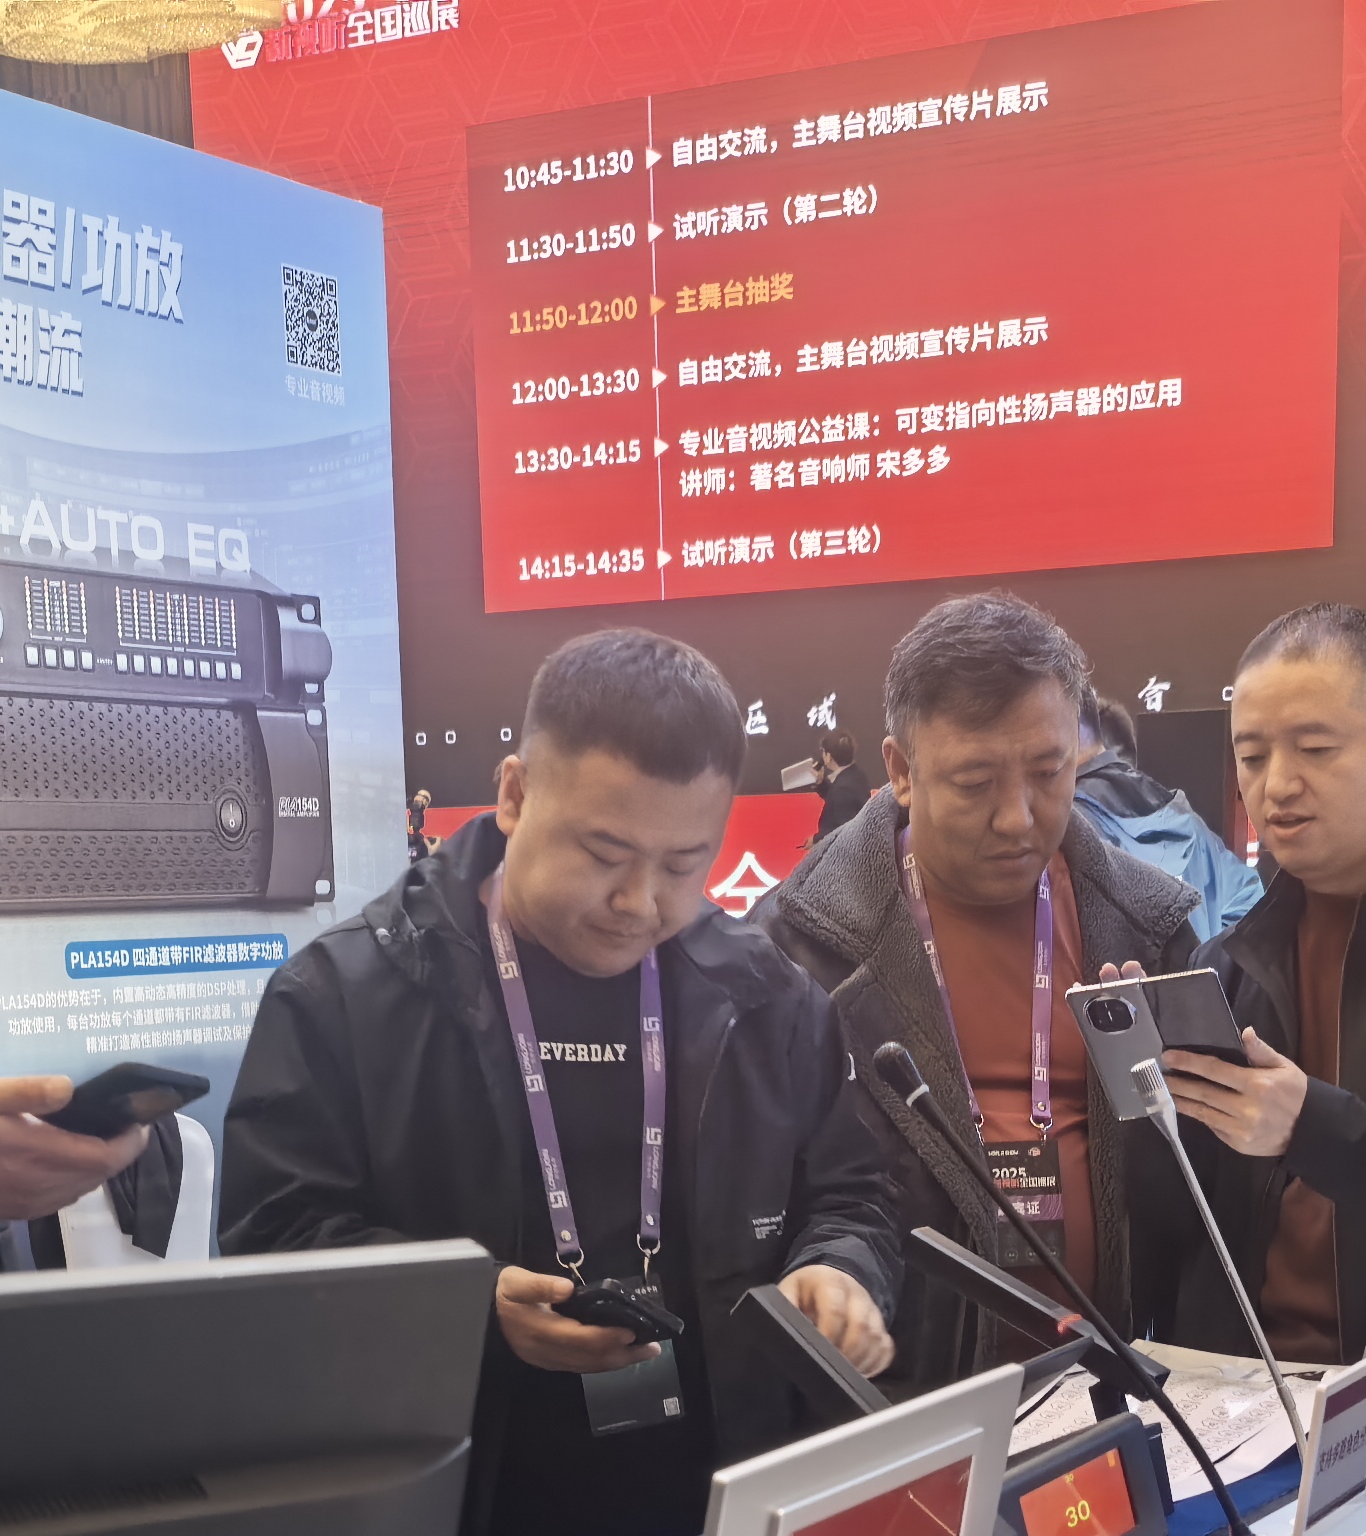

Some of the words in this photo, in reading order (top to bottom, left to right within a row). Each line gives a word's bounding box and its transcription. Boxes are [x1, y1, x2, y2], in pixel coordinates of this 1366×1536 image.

[265, 0, 459, 62] 新视听全国巡展
[671, 81, 1049, 168] 自由交流，主舞台视频宣传片展示
[503, 148, 635, 193] 10:45-11:30
[673, 184, 879, 242] 试听演示（第二轮）
[506, 222, 636, 265] 11:30-11:50
[508, 295, 638, 336] 11:50-12:00
[675, 273, 795, 315] 主舞台抽奖
[677, 316, 1049, 388] 自由交流，主舞台视频宣传片展示
[511, 368, 640, 406] 12:00-13:30
[678, 378, 1183, 459] 专业音视频公益课：可变指向性扬声器的应用
[513, 439, 641, 475] 13:30-14:15
[679, 453, 870, 499] 讲师：著名音响师
[876, 446, 951, 481] 宋多多
[186, 521, 252, 572] EQ
[517, 546, 645, 581] 14:15-14:35
[681, 524, 882, 571] 试听演示（第三轮）
[70, 948, 129, 970] PLA154D
[132, 940, 284, 968] 四通道带FIR滤波器数字功放
[538, 1041, 627, 1063] EVERDAY
[1065, 1499, 1091, 1528] 30
